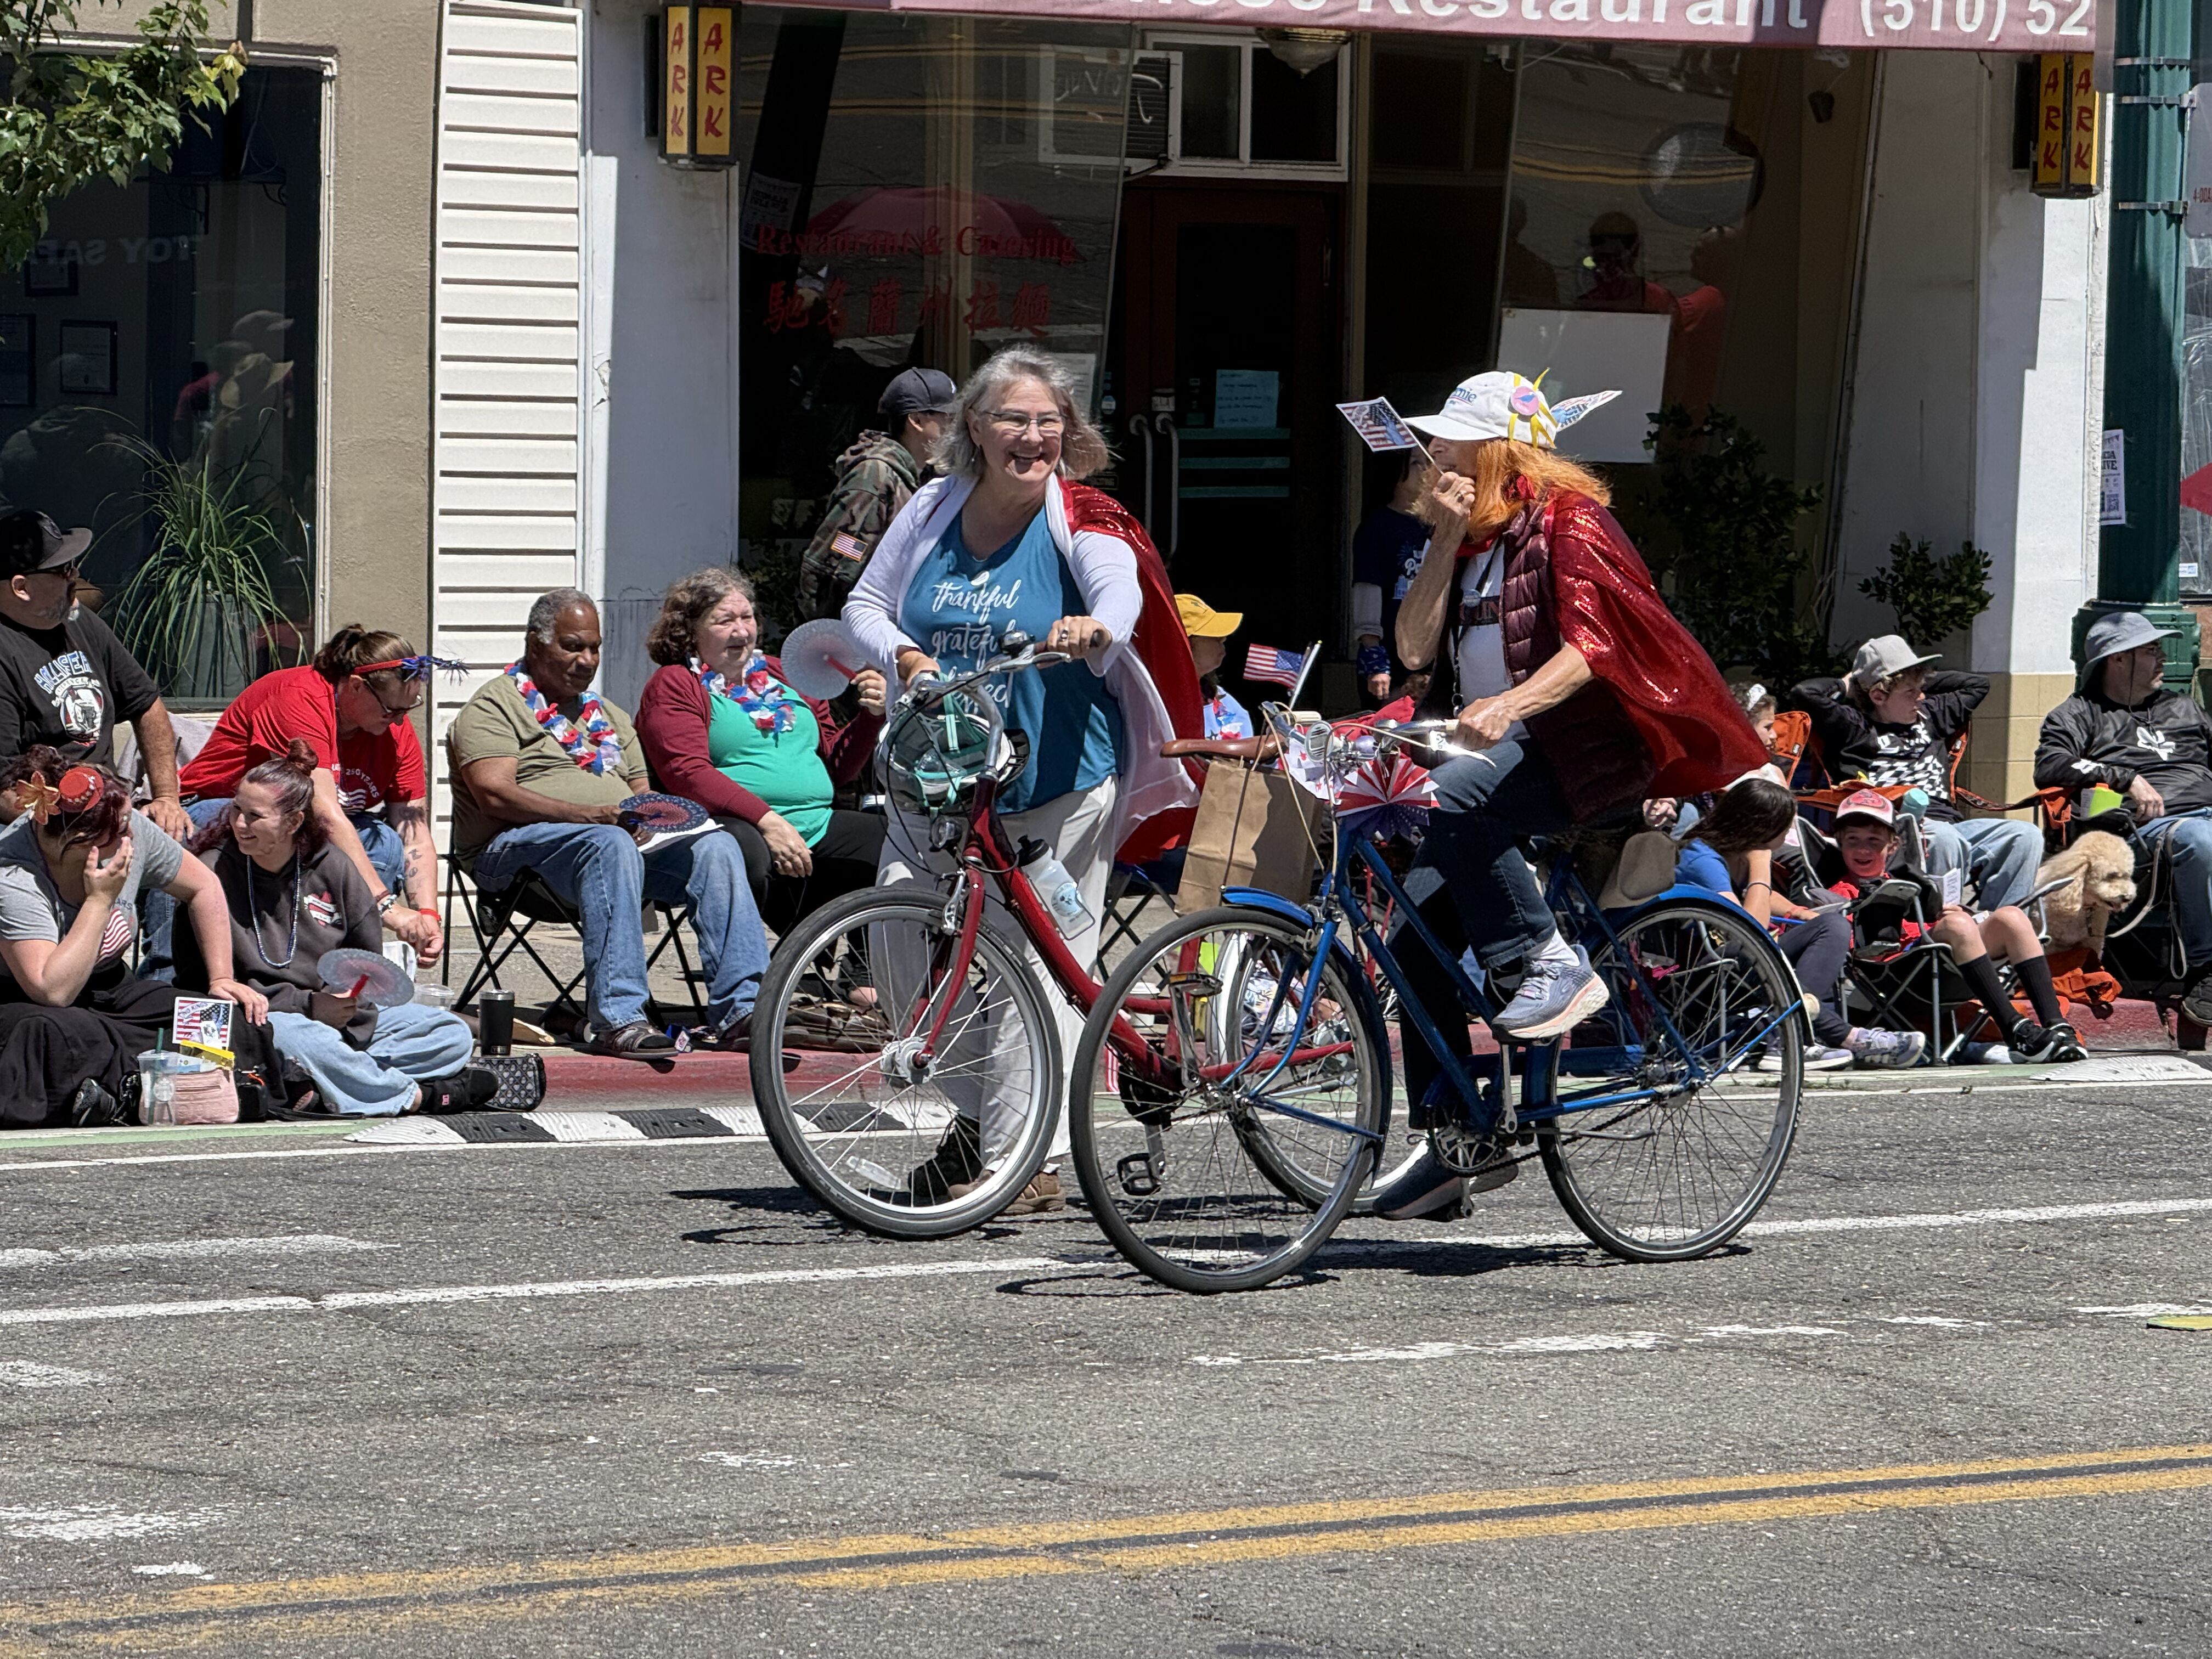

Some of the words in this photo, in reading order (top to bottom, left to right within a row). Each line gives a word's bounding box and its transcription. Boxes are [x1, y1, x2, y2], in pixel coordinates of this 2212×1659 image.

[671, 22, 686, 138] ARK
[702, 22, 726, 138] ARK
[2042, 67, 2061, 170] ARK
[2074, 68, 2093, 171] ARK
[757, 225, 913, 256] Restaurant
[922, 226, 943, 256] &
[955, 226, 1076, 267] Catering
[932, 579, 1022, 625] thankful
[360, 772, 380, 798] YEARS
